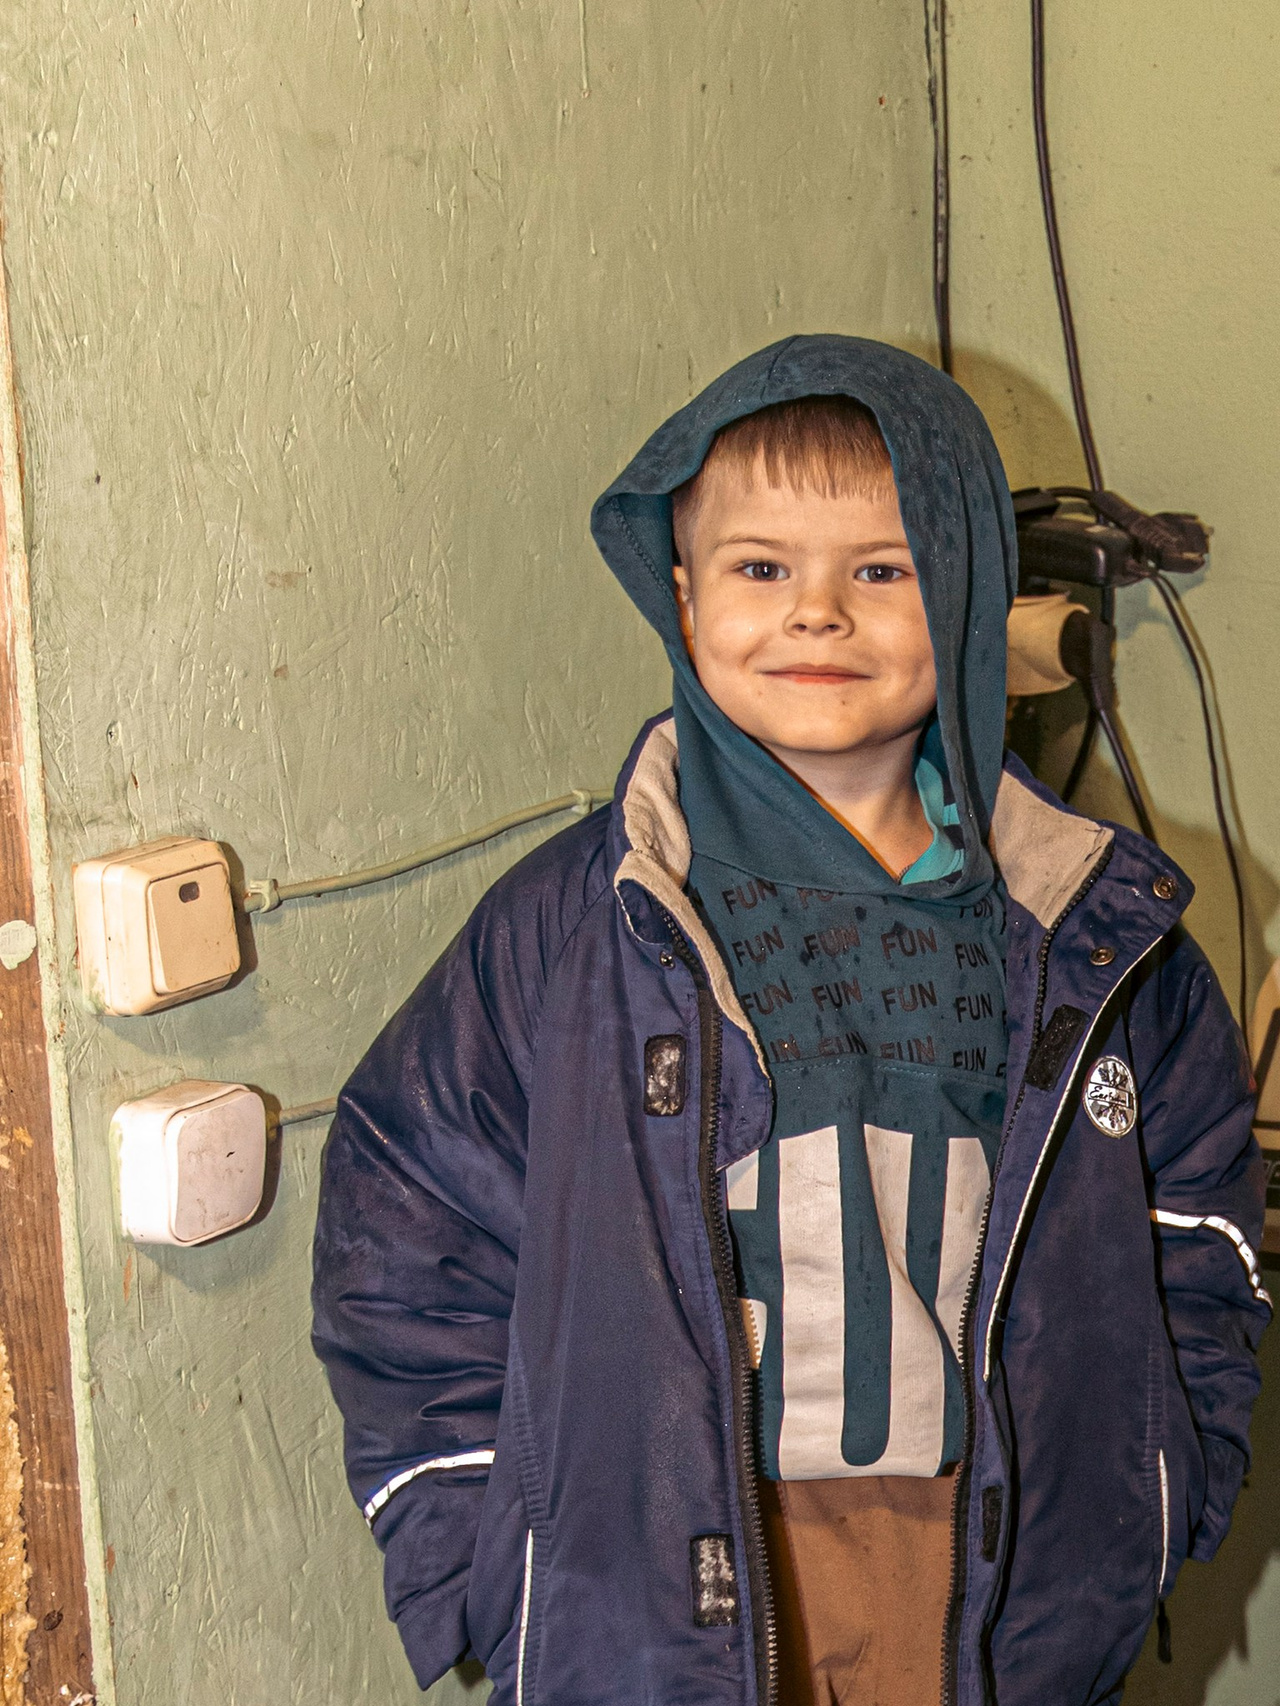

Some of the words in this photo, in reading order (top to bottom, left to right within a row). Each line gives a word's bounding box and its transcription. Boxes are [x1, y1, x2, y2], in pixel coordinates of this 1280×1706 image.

[722, 878, 778, 916] FUN
[732, 925, 785, 967] FUN
[804, 925, 861, 960] FUN
[881, 927, 937, 960] FUN
[955, 943, 990, 969] FUN
[812, 977, 863, 1011] FUN
[881, 981, 937, 1015] FUN
[956, 993, 993, 1023] FUN
